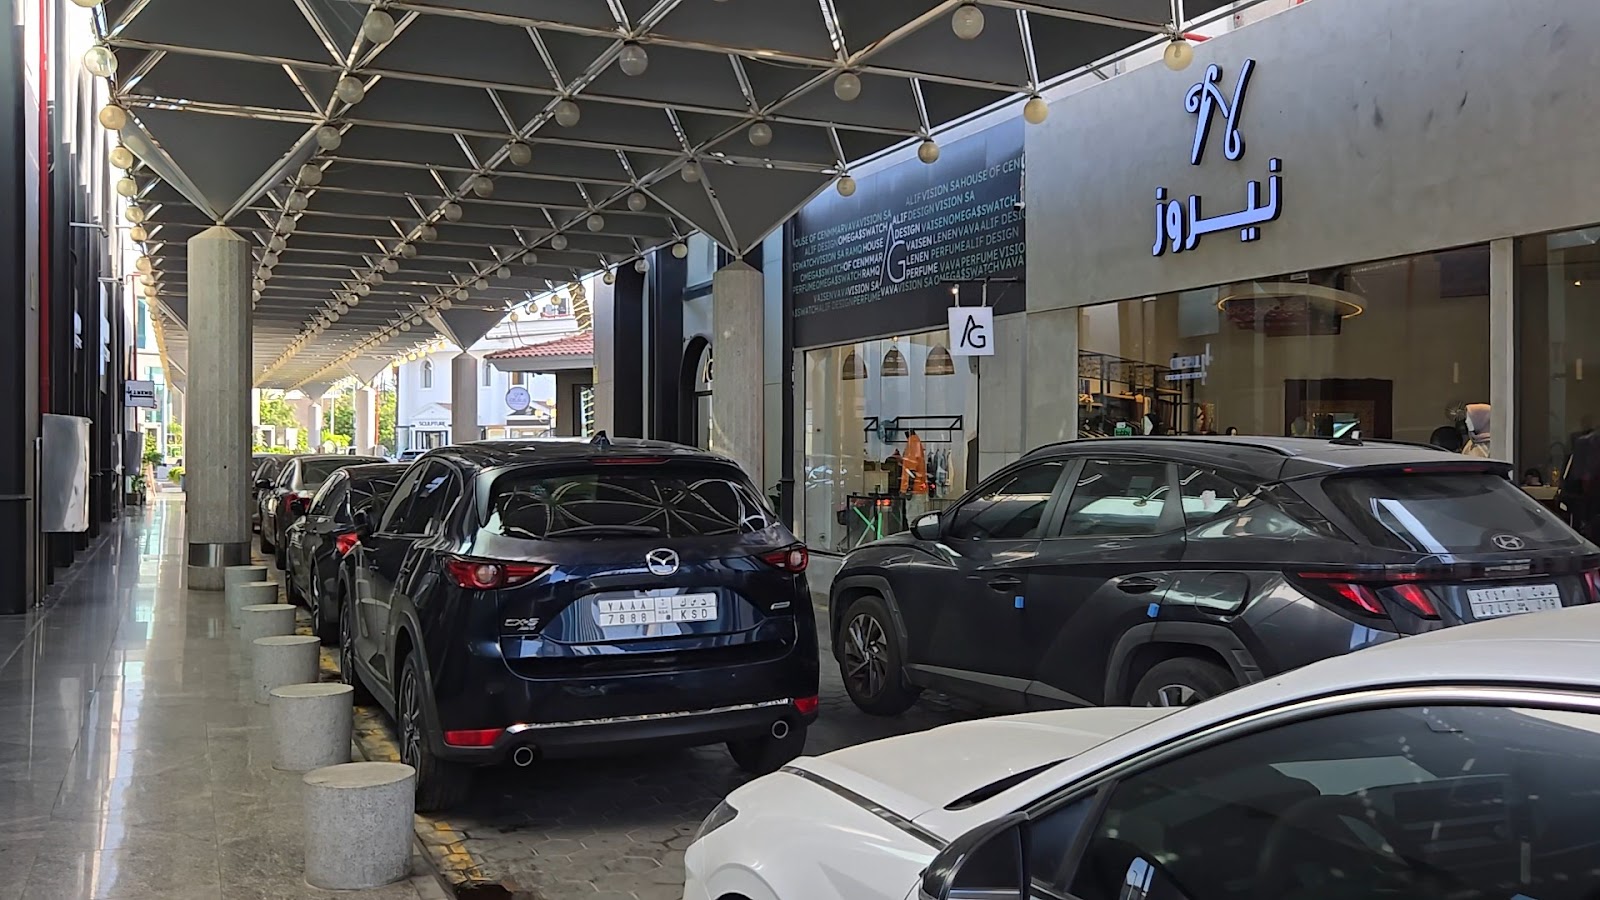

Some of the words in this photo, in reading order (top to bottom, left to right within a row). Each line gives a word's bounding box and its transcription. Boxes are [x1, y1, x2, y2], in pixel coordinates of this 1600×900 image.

[989, 165, 1000, 178] OF
[883, 209, 892, 220] SA
[892, 211, 908, 226] ALIF
[964, 190, 975, 203] SA
[1152, 158, 1282, 256] نيروز
[894, 222, 920, 240] DESIGN
[906, 235, 932, 251] VAISEN
[933, 227, 957, 244] LENEN
[980, 216, 999, 231] ALIF
[862, 237, 883, 252] HOUSE
[906, 250, 930, 265] LENEN
[986, 226, 1019, 245] DESIGN
[843, 260, 852, 271] OF
[906, 262, 938, 280] PERFUME
[961, 248, 998, 267] PERFUME
[848, 282, 870, 296] VISION
[871, 280, 880, 291] SA
[960, 315, 986, 348] AG
[608, 612, 647, 624] 7888
[680, 609, 707, 620] KSD
